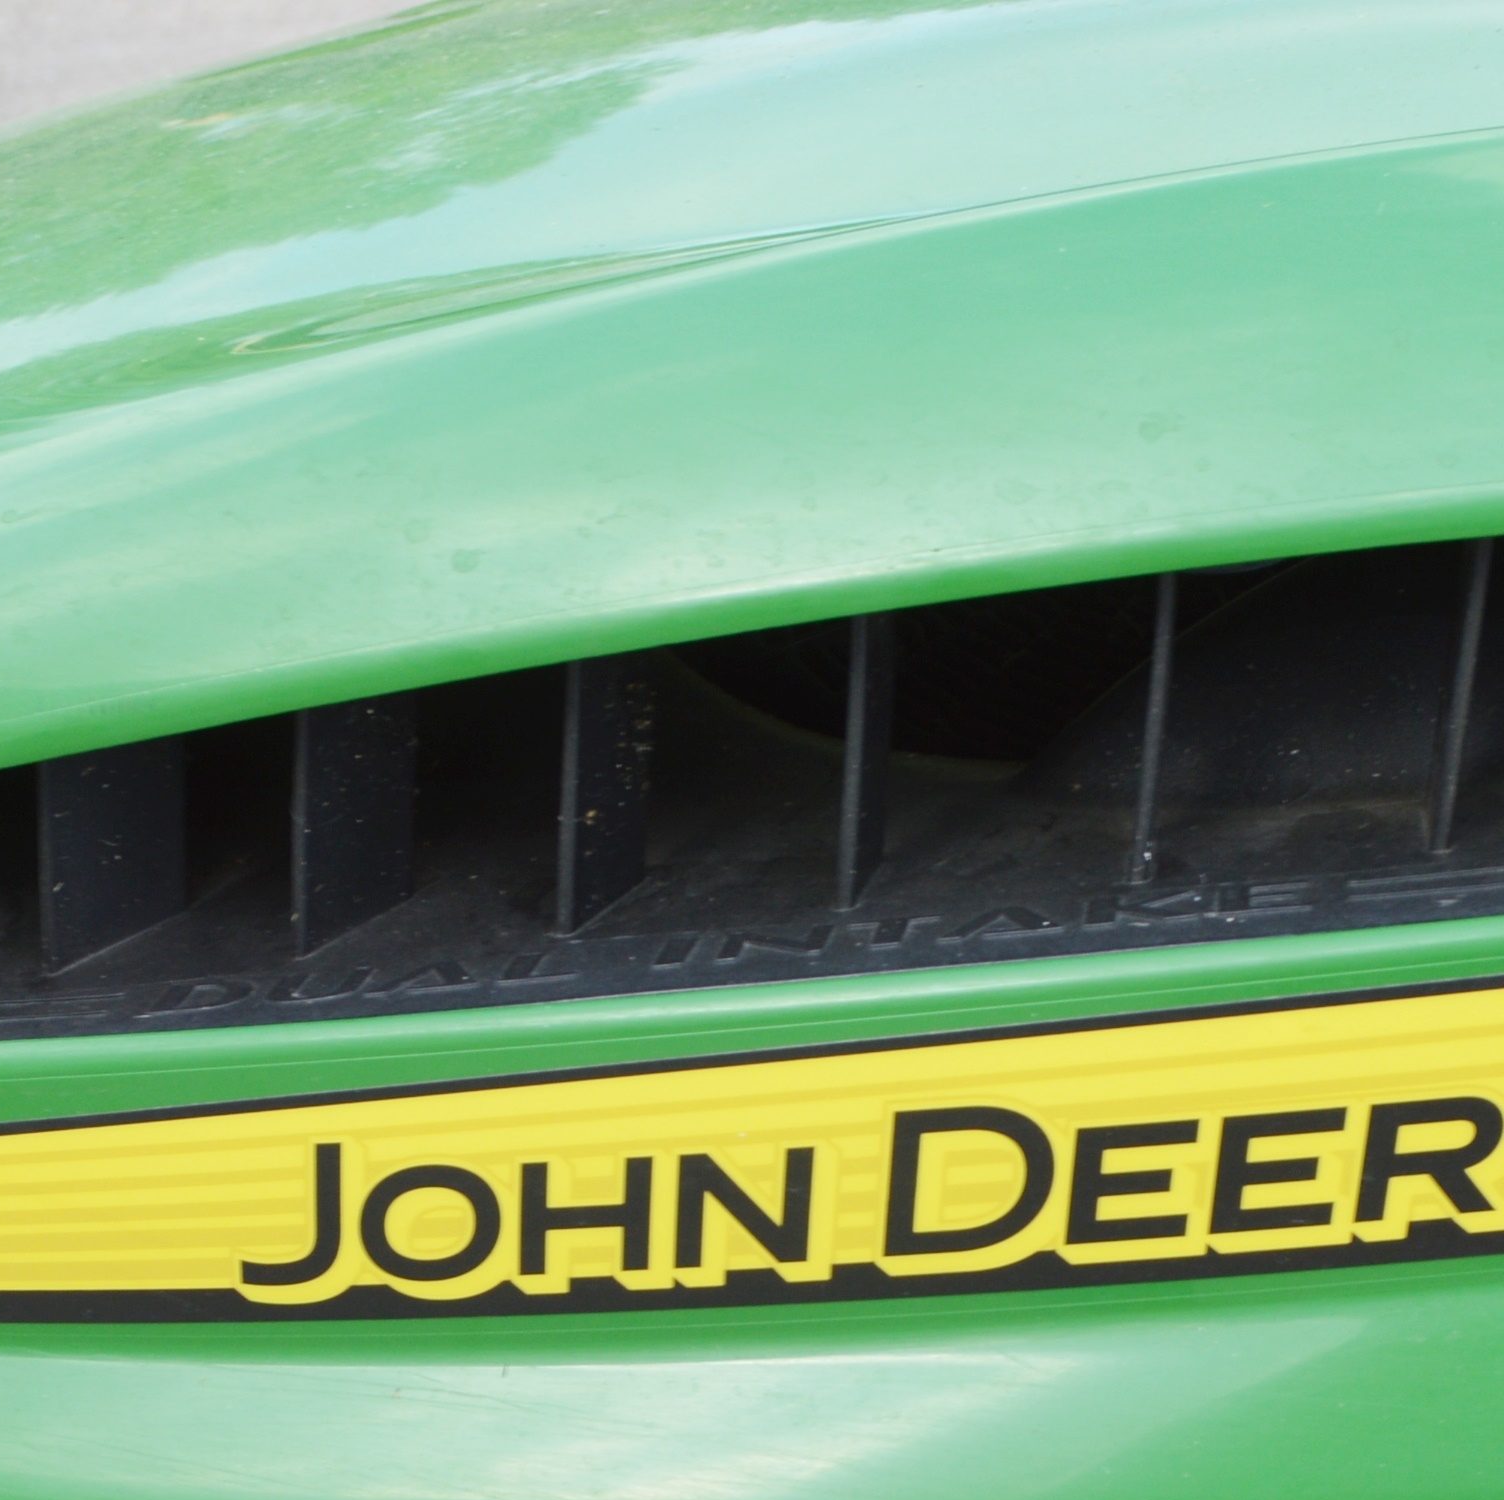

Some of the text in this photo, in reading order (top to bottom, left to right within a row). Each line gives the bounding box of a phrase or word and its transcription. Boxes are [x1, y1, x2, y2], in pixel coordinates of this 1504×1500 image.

[134, 880, 1314, 1019] DUAL INTAKE
[238, 1142, 816, 1289] JOHN
